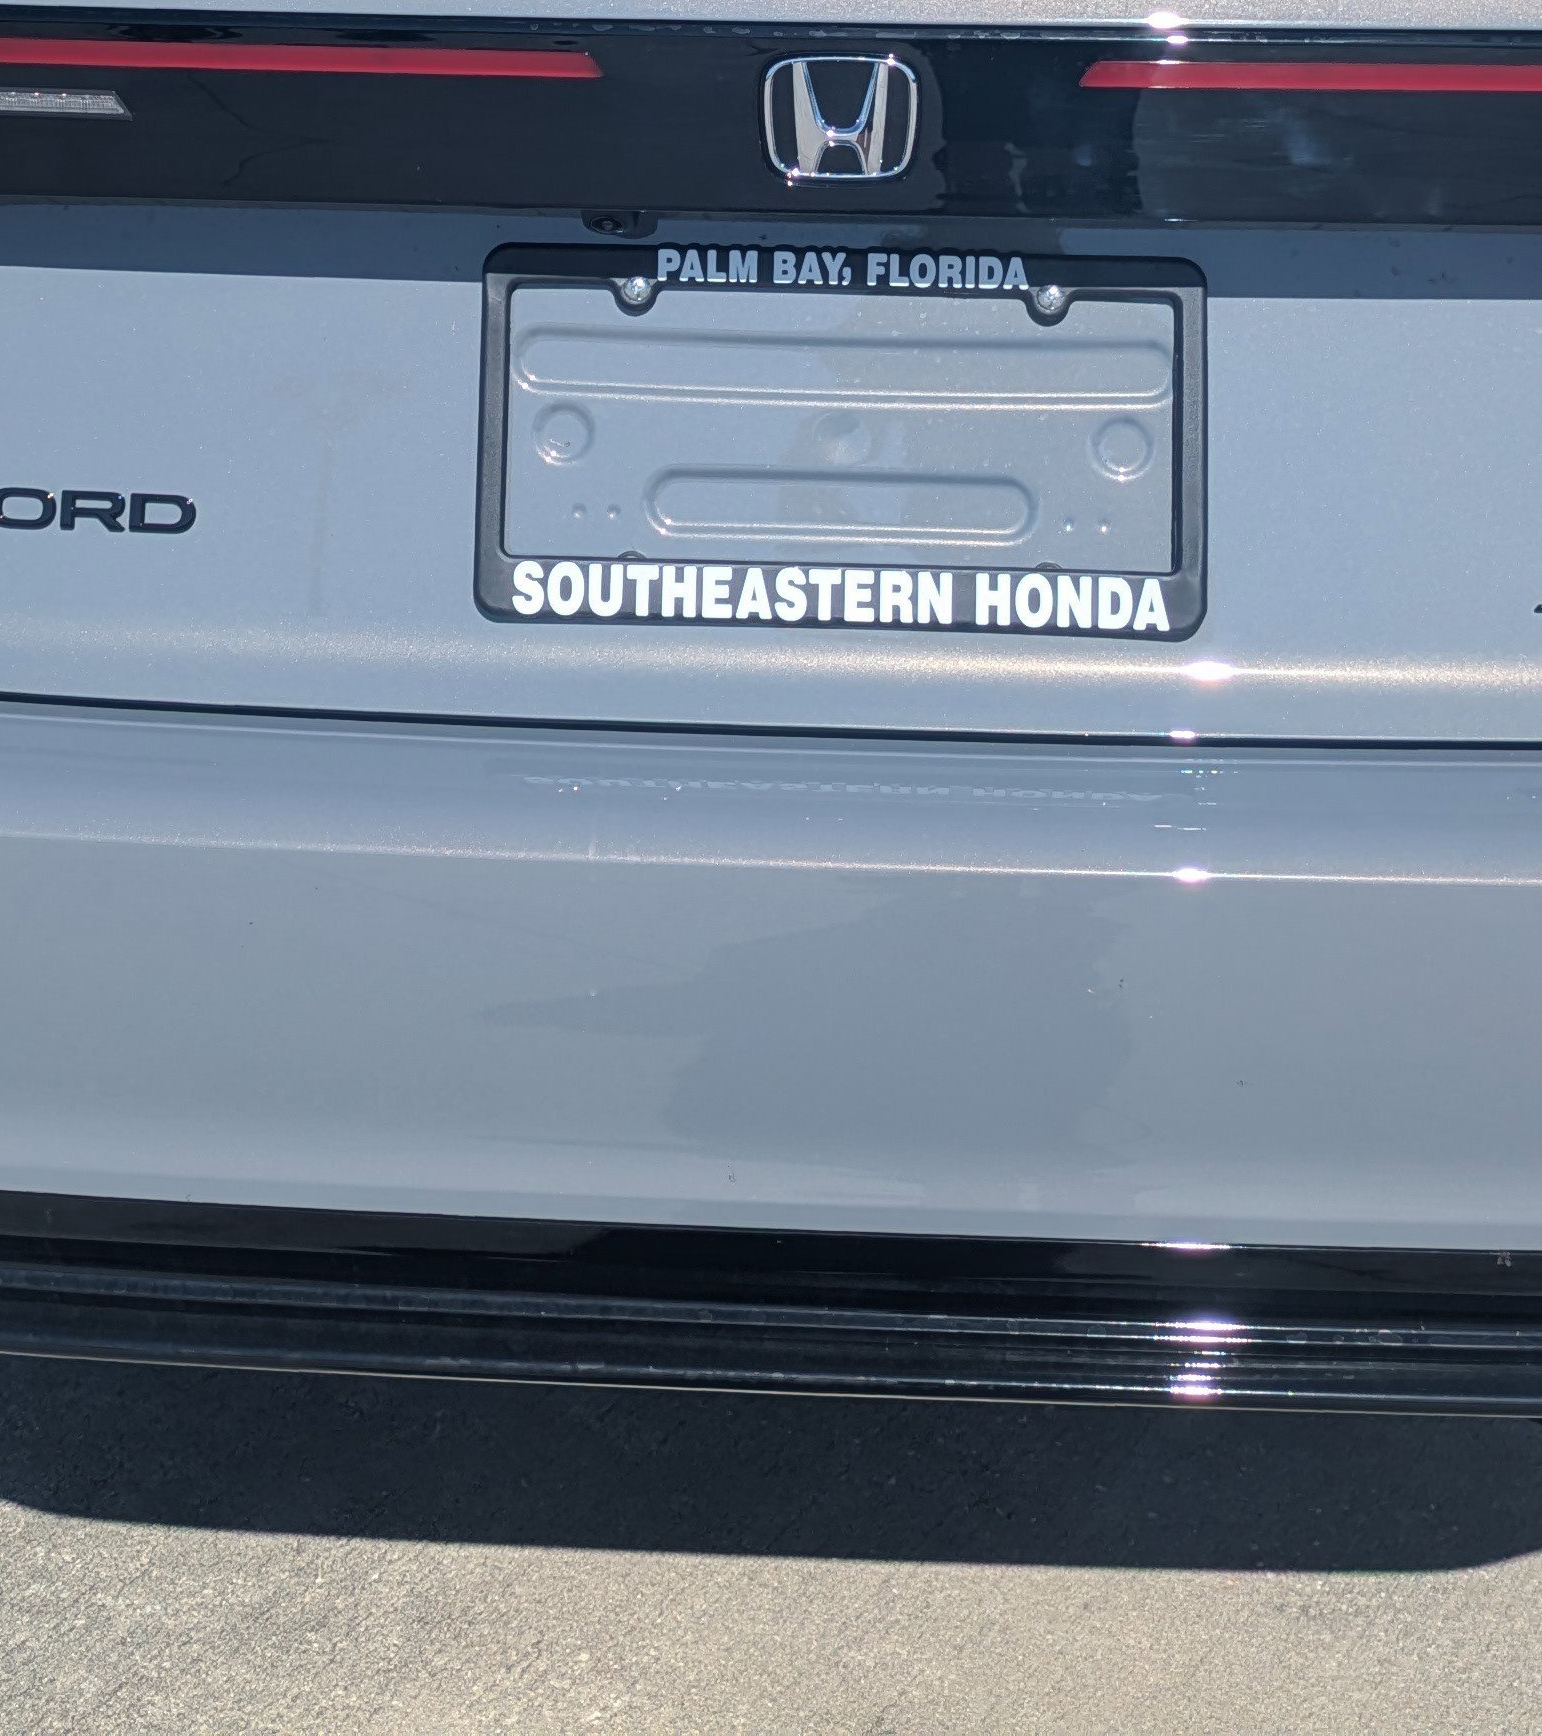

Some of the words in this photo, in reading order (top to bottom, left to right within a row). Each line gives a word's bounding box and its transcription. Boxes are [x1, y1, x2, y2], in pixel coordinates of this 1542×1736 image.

[657, 249, 758, 283] PALM
[773, 251, 852, 286] BAY,
[866, 252, 1029, 290] FLORIDA
[512, 561, 953, 625] SOUTHEASTERN
[975, 573, 1171, 632] HONDA
